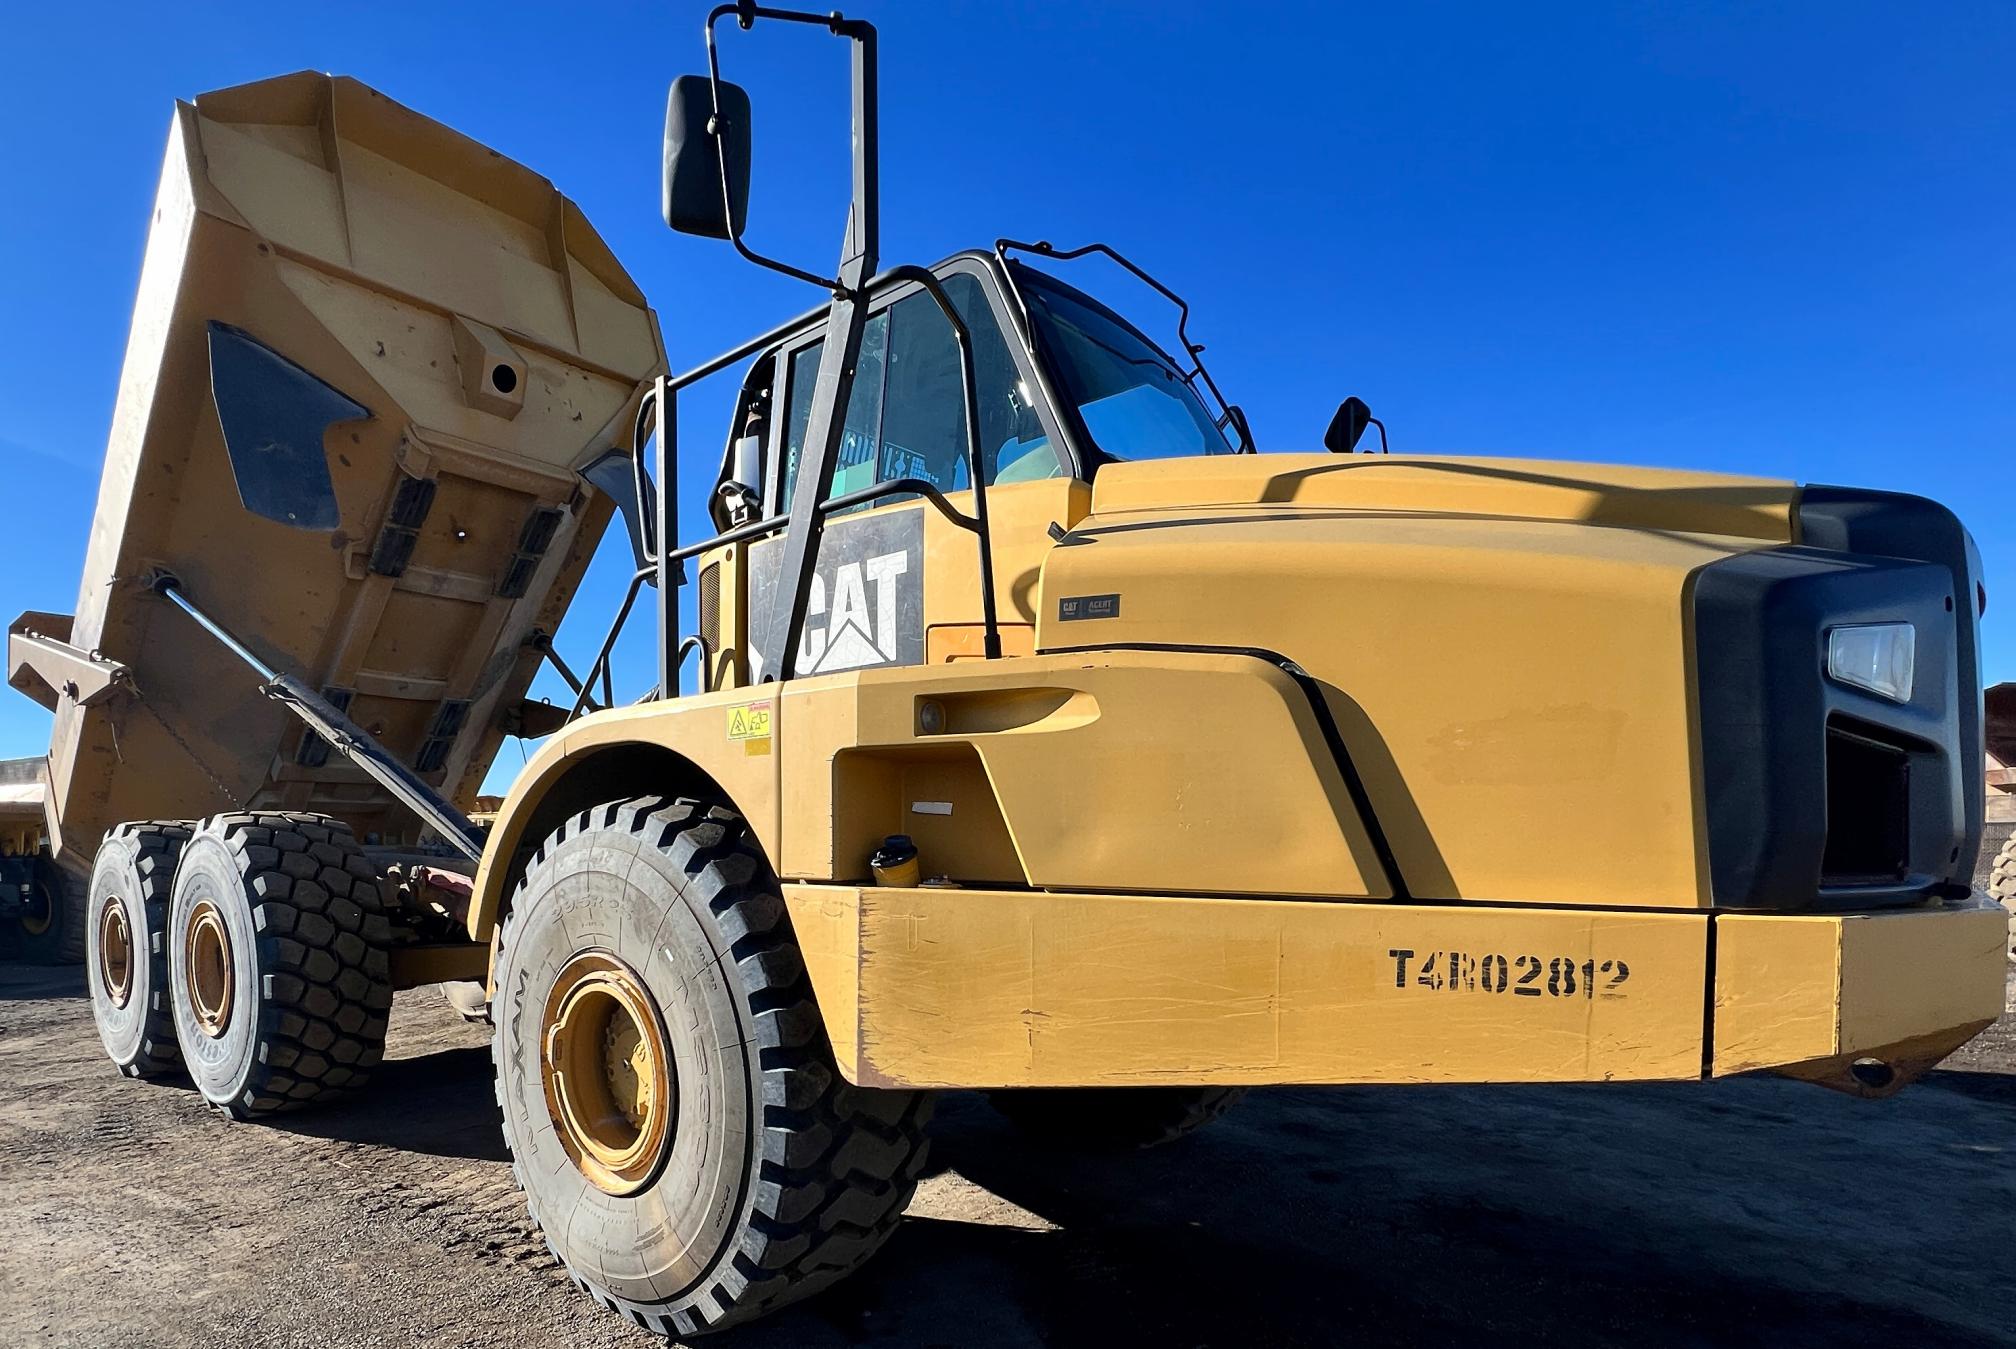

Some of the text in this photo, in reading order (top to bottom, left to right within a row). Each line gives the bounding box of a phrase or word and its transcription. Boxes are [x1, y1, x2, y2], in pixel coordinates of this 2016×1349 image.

[795, 550, 908, 675] CAT
[1063, 601, 1078, 612] CAT
[1388, 949, 1630, 1000] T4R02812
[511, 967, 539, 1157] MAXAM
